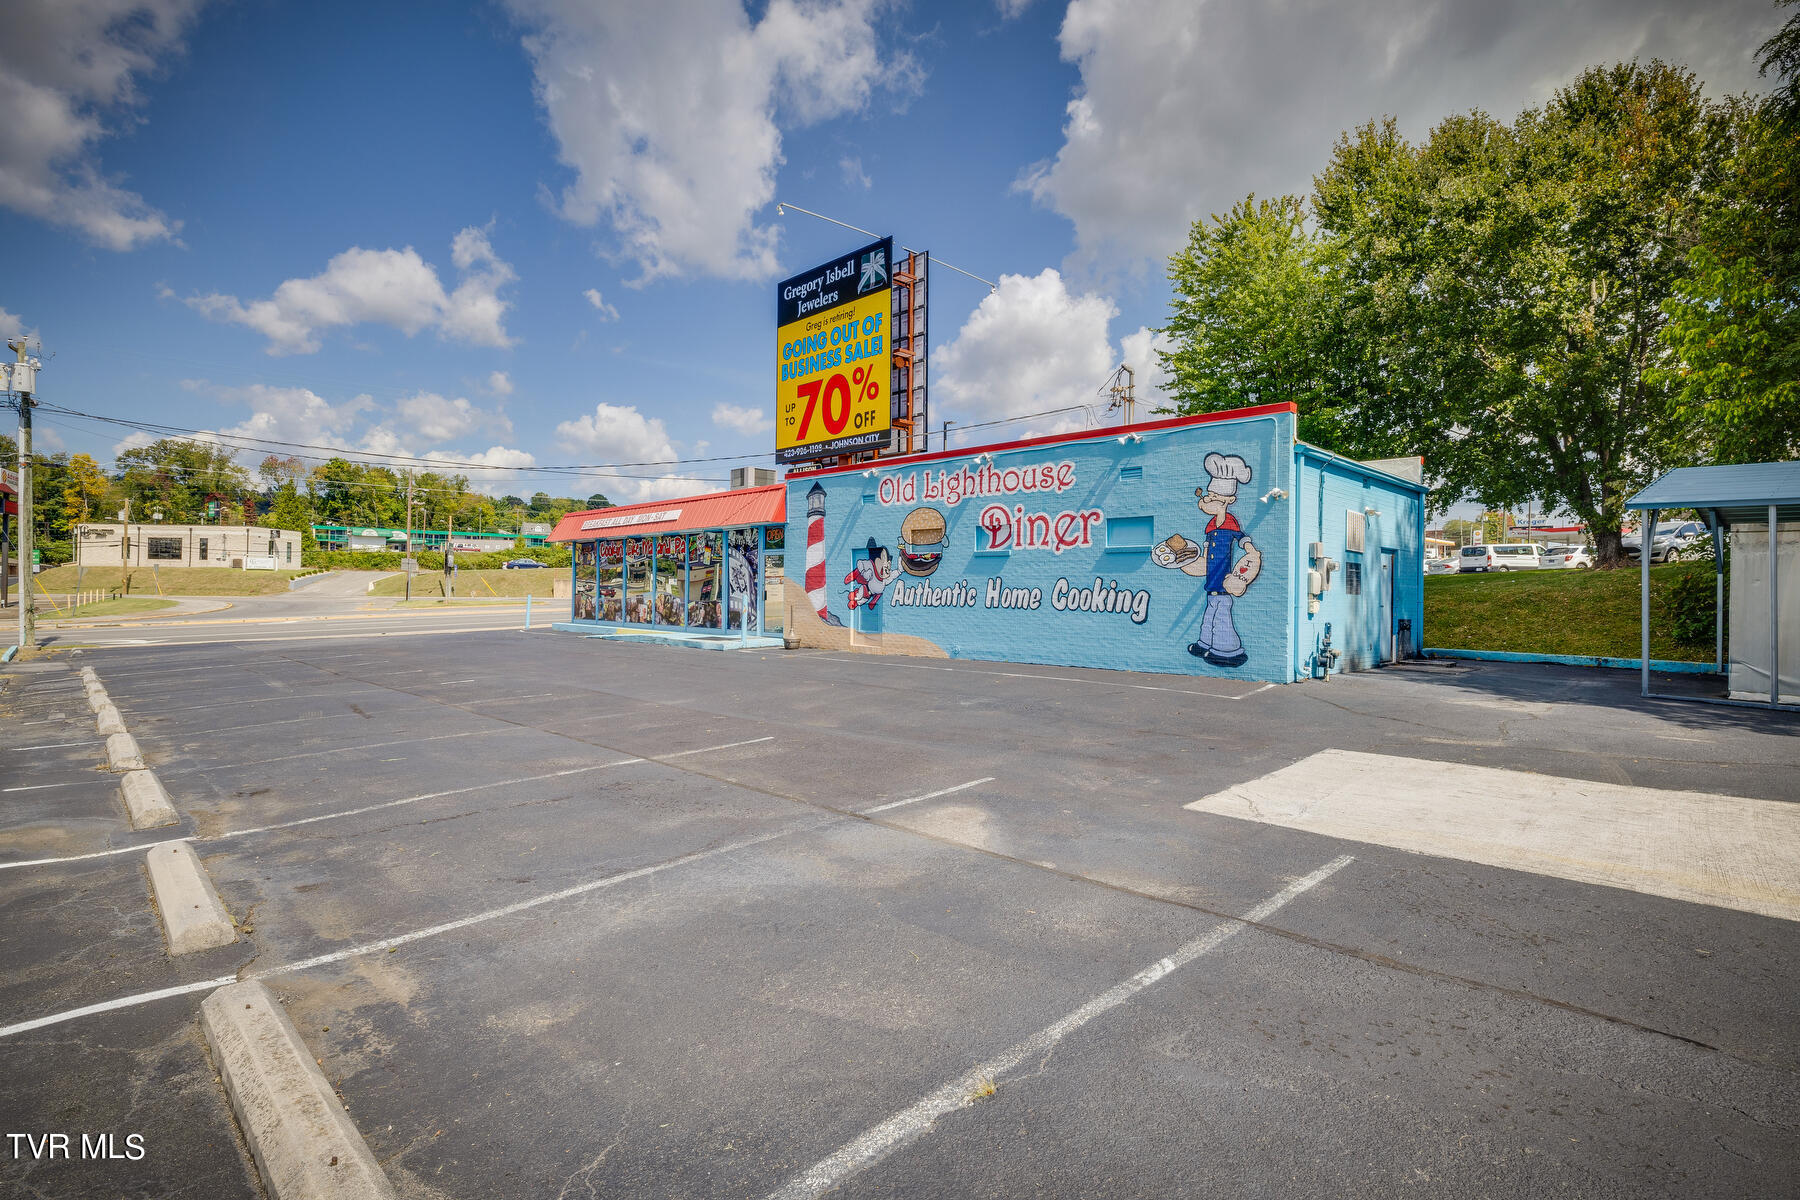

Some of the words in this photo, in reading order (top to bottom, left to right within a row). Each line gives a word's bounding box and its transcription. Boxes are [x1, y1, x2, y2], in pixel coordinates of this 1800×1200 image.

[784, 276, 824, 300] Gregory
[826, 260, 855, 285] Isbell
[797, 290, 838, 318] Jewelers
[806, 320, 822, 332] Greg
[822, 316, 828, 326] is
[829, 306, 856, 324] retiring!
[783, 331, 827, 360] GOING
[830, 320, 860, 346] OUT
[862, 312, 882, 336] OF
[782, 348, 842, 382] BUSINESS
[845, 334, 882, 364] SALE!
[785, 403, 796, 413] UP
[796, 364, 879, 441] 70%
[854, 410, 876, 429] OFF
[785, 417, 795, 426] TO
[830, 436, 864, 448] JOHNSON
[864, 433, 880, 443] CITY
[878, 470, 917, 505] Old
[923, 462, 1075, 506] Lighthouse
[767, 528, 784, 540] OPEN
[980, 504, 1102, 552] Diner
[890, 578, 977, 608] Authentic
[984, 577, 1042, 610] Home
[1051, 577, 1150, 625] Cooking
